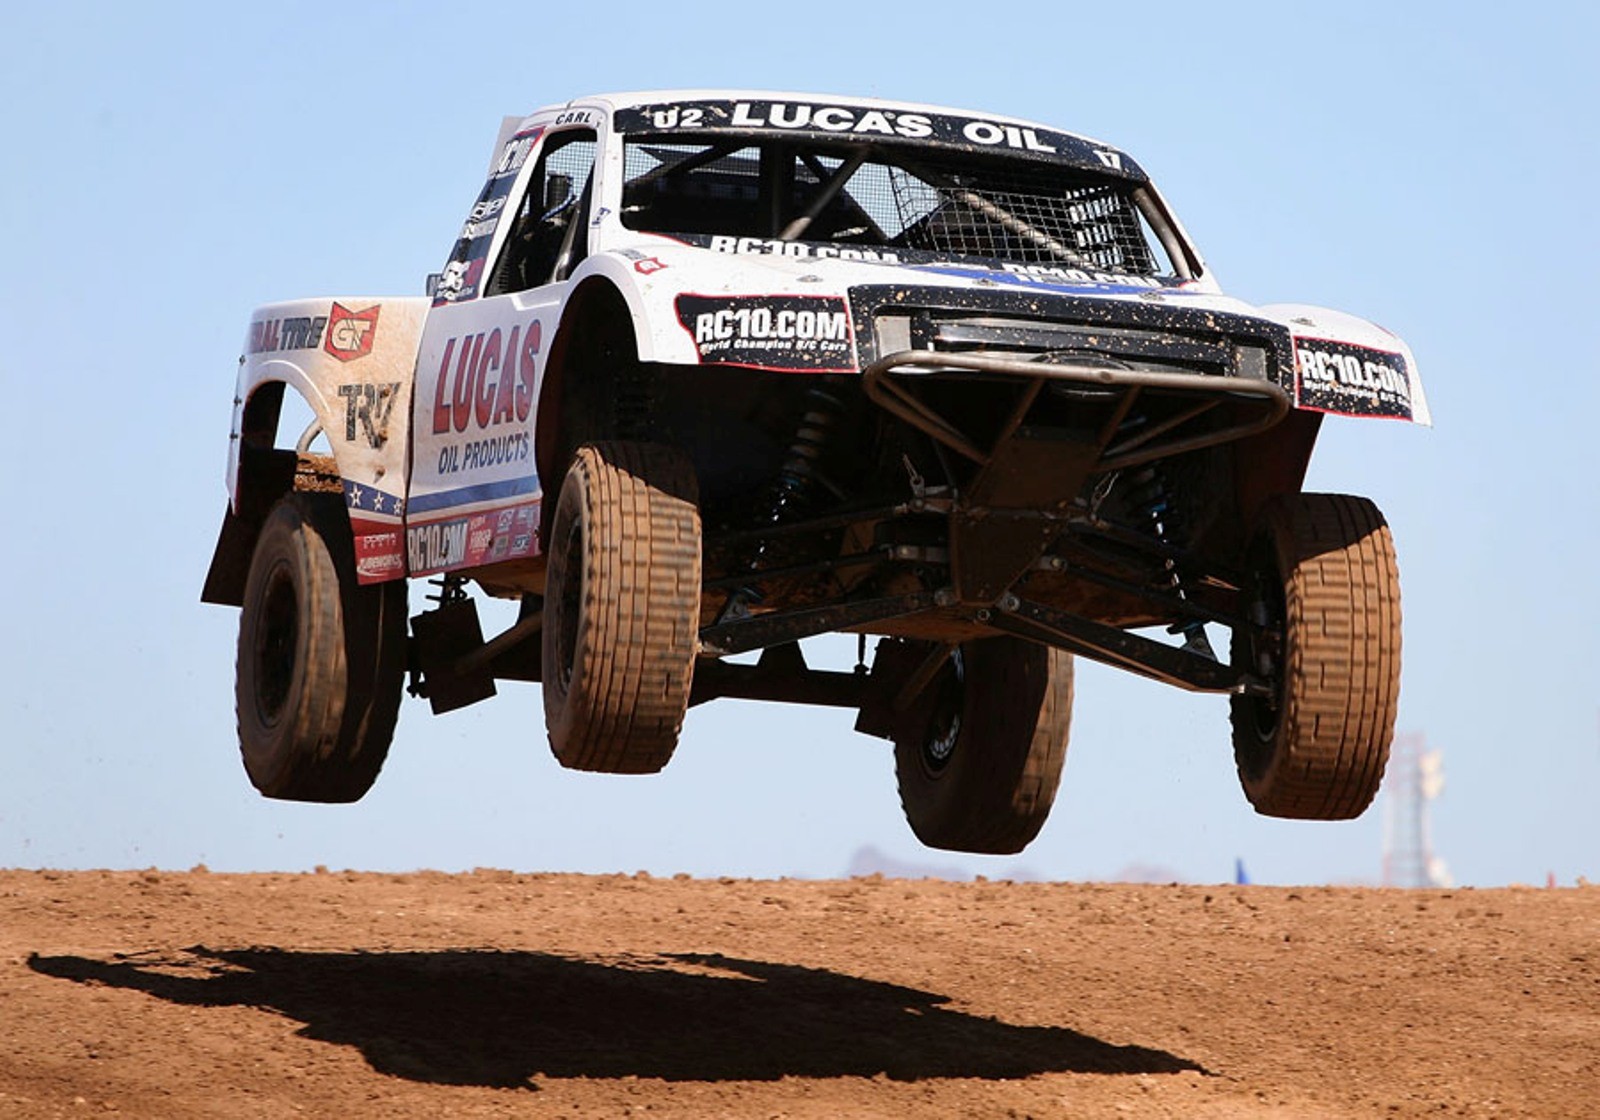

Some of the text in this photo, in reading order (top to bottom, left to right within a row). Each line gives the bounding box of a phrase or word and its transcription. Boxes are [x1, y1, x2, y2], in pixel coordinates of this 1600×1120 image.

[555, 111, 592, 125] CARL
[731, 103, 1057, 154] LUCAS OIL
[696, 308, 847, 343] RC10.COM
[432, 318, 542, 435] LUCAS
[1297, 349, 1412, 400] RC10.COM
[438, 431, 530, 475] OIL PRODUCTS
